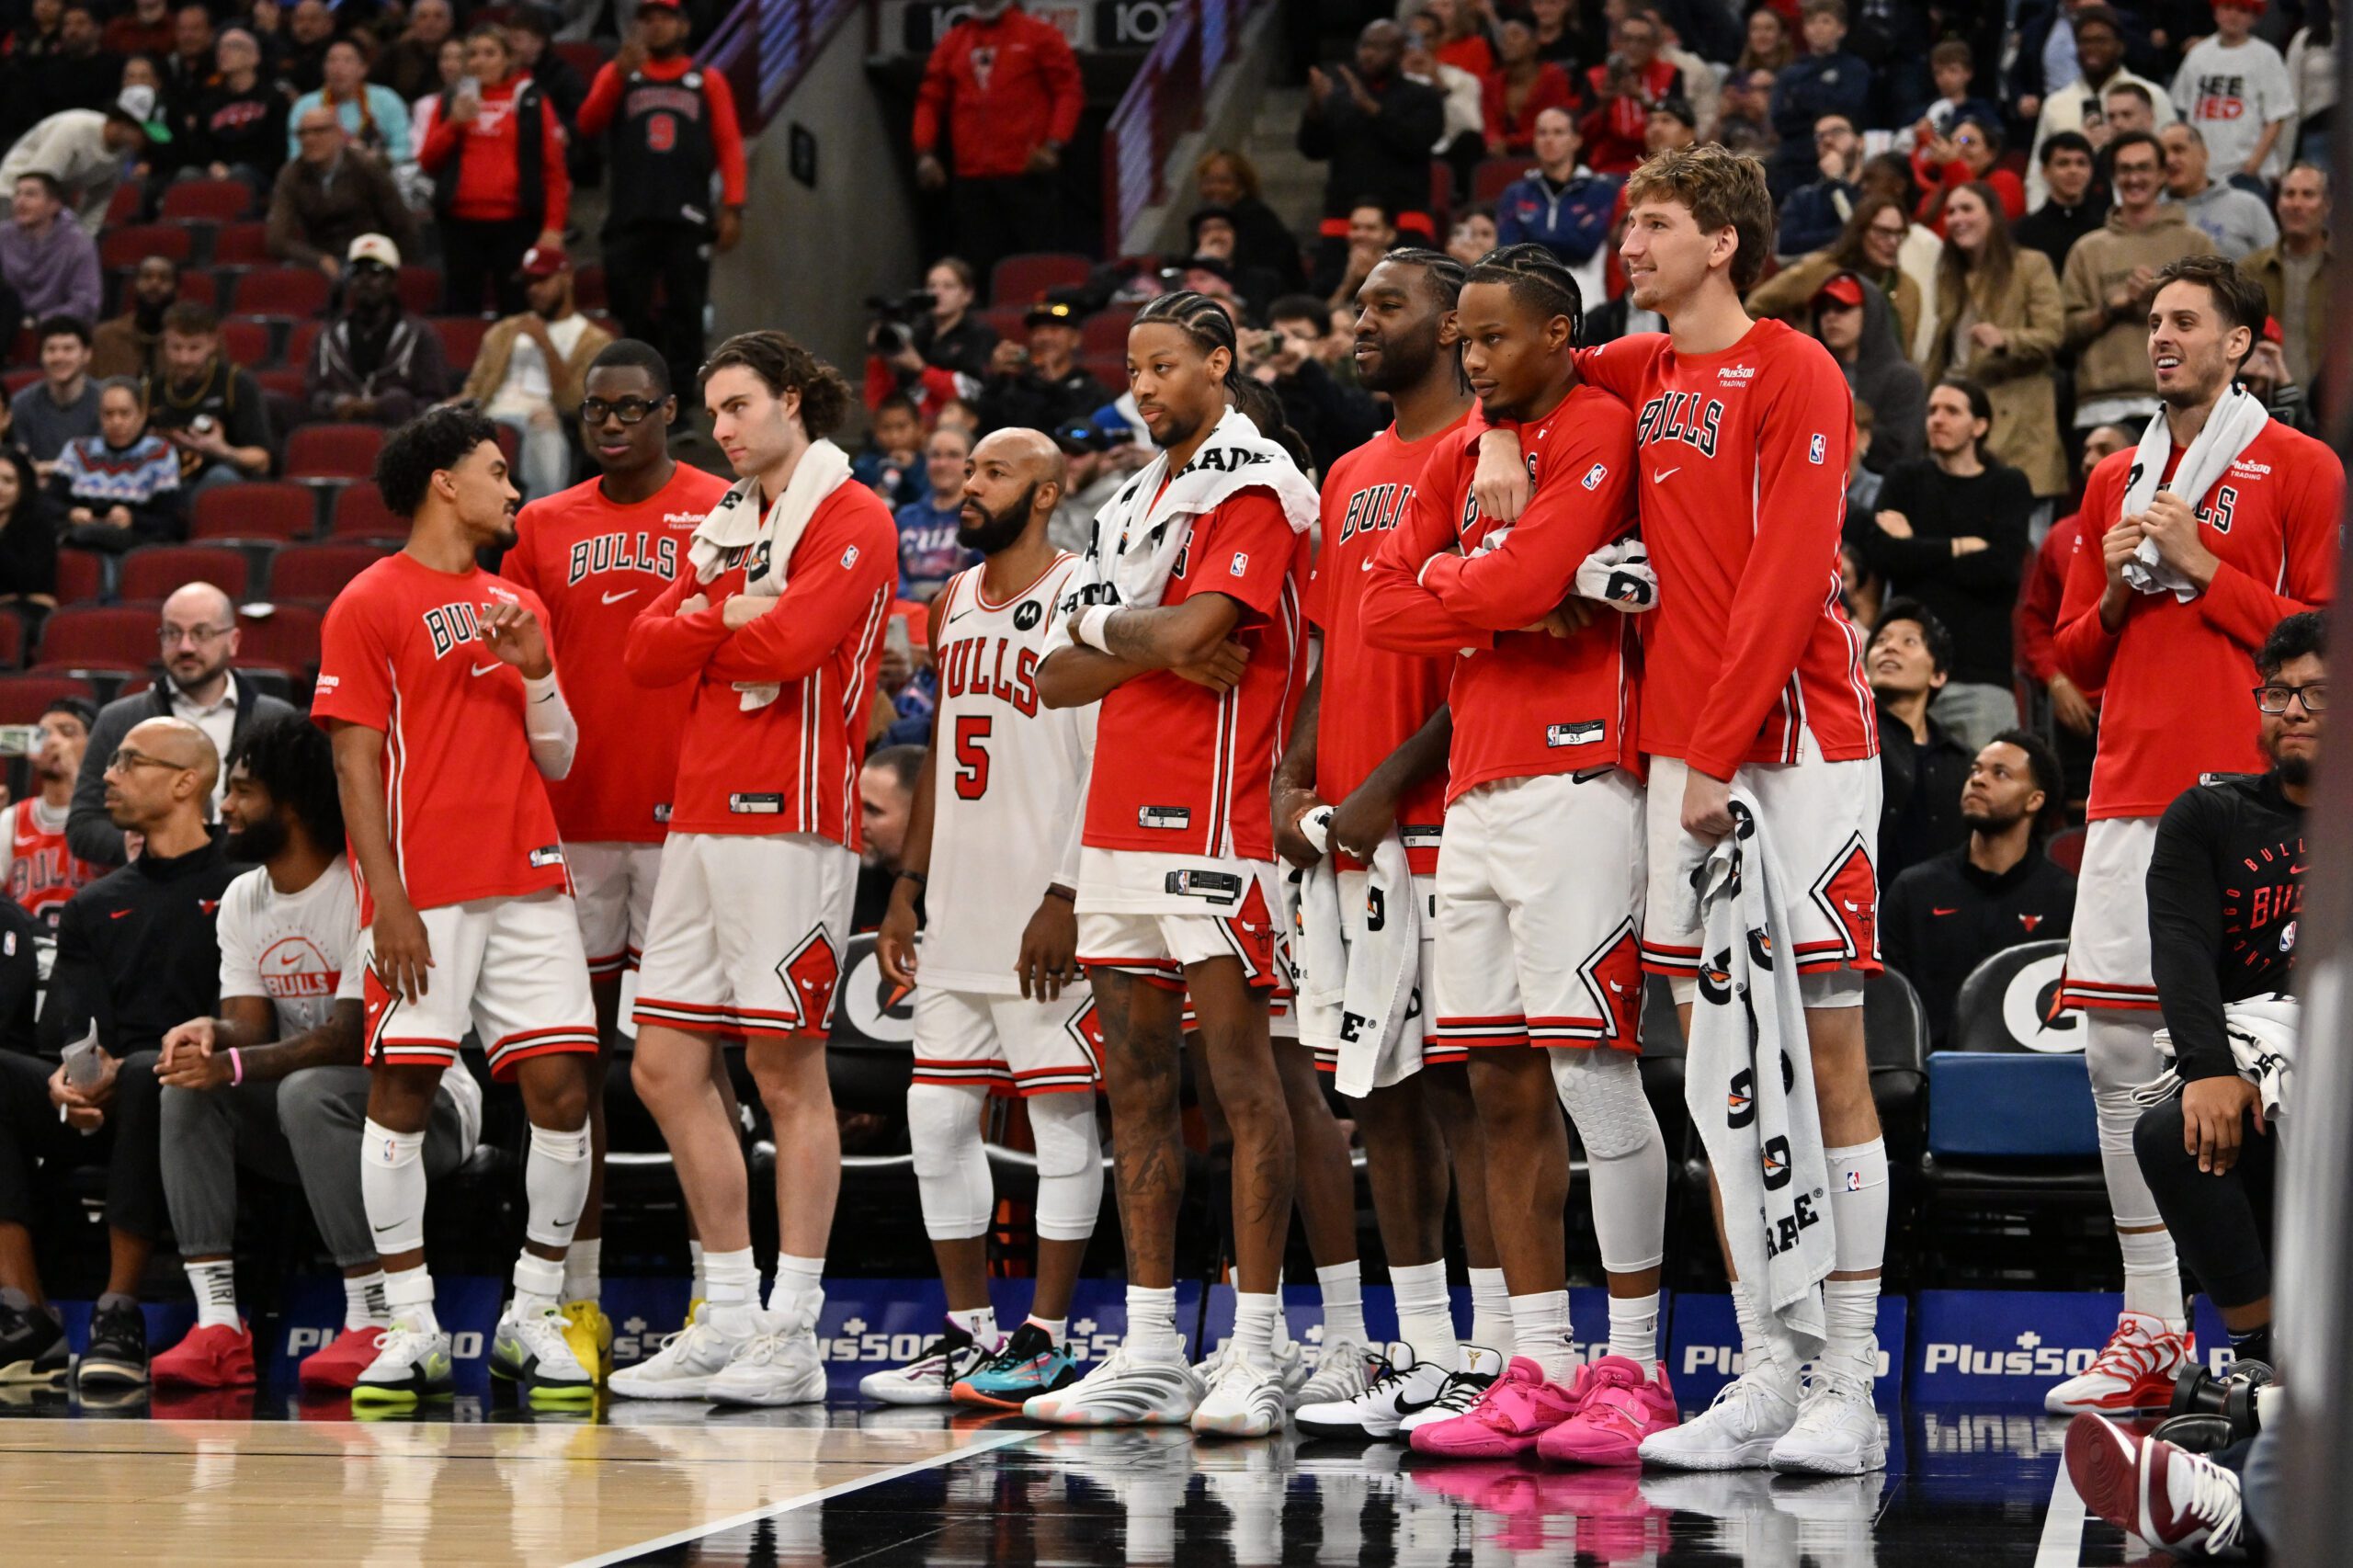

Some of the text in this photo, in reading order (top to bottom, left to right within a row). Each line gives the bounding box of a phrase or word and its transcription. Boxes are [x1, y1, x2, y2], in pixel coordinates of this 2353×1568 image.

[1717, 365, 1755, 378] Plus500
[2231, 471, 2261, 481] TRADING
[2232, 460, 2271, 474] lus500
[1339, 483, 1412, 546] BULL
[567, 532, 677, 587] BULLS
[423, 601, 494, 661] BUL
[955, 715, 993, 801] 5
[11, 846, 90, 902] BULL
[2244, 838, 2306, 872] BULL
[264, 974, 329, 995] BULLS
